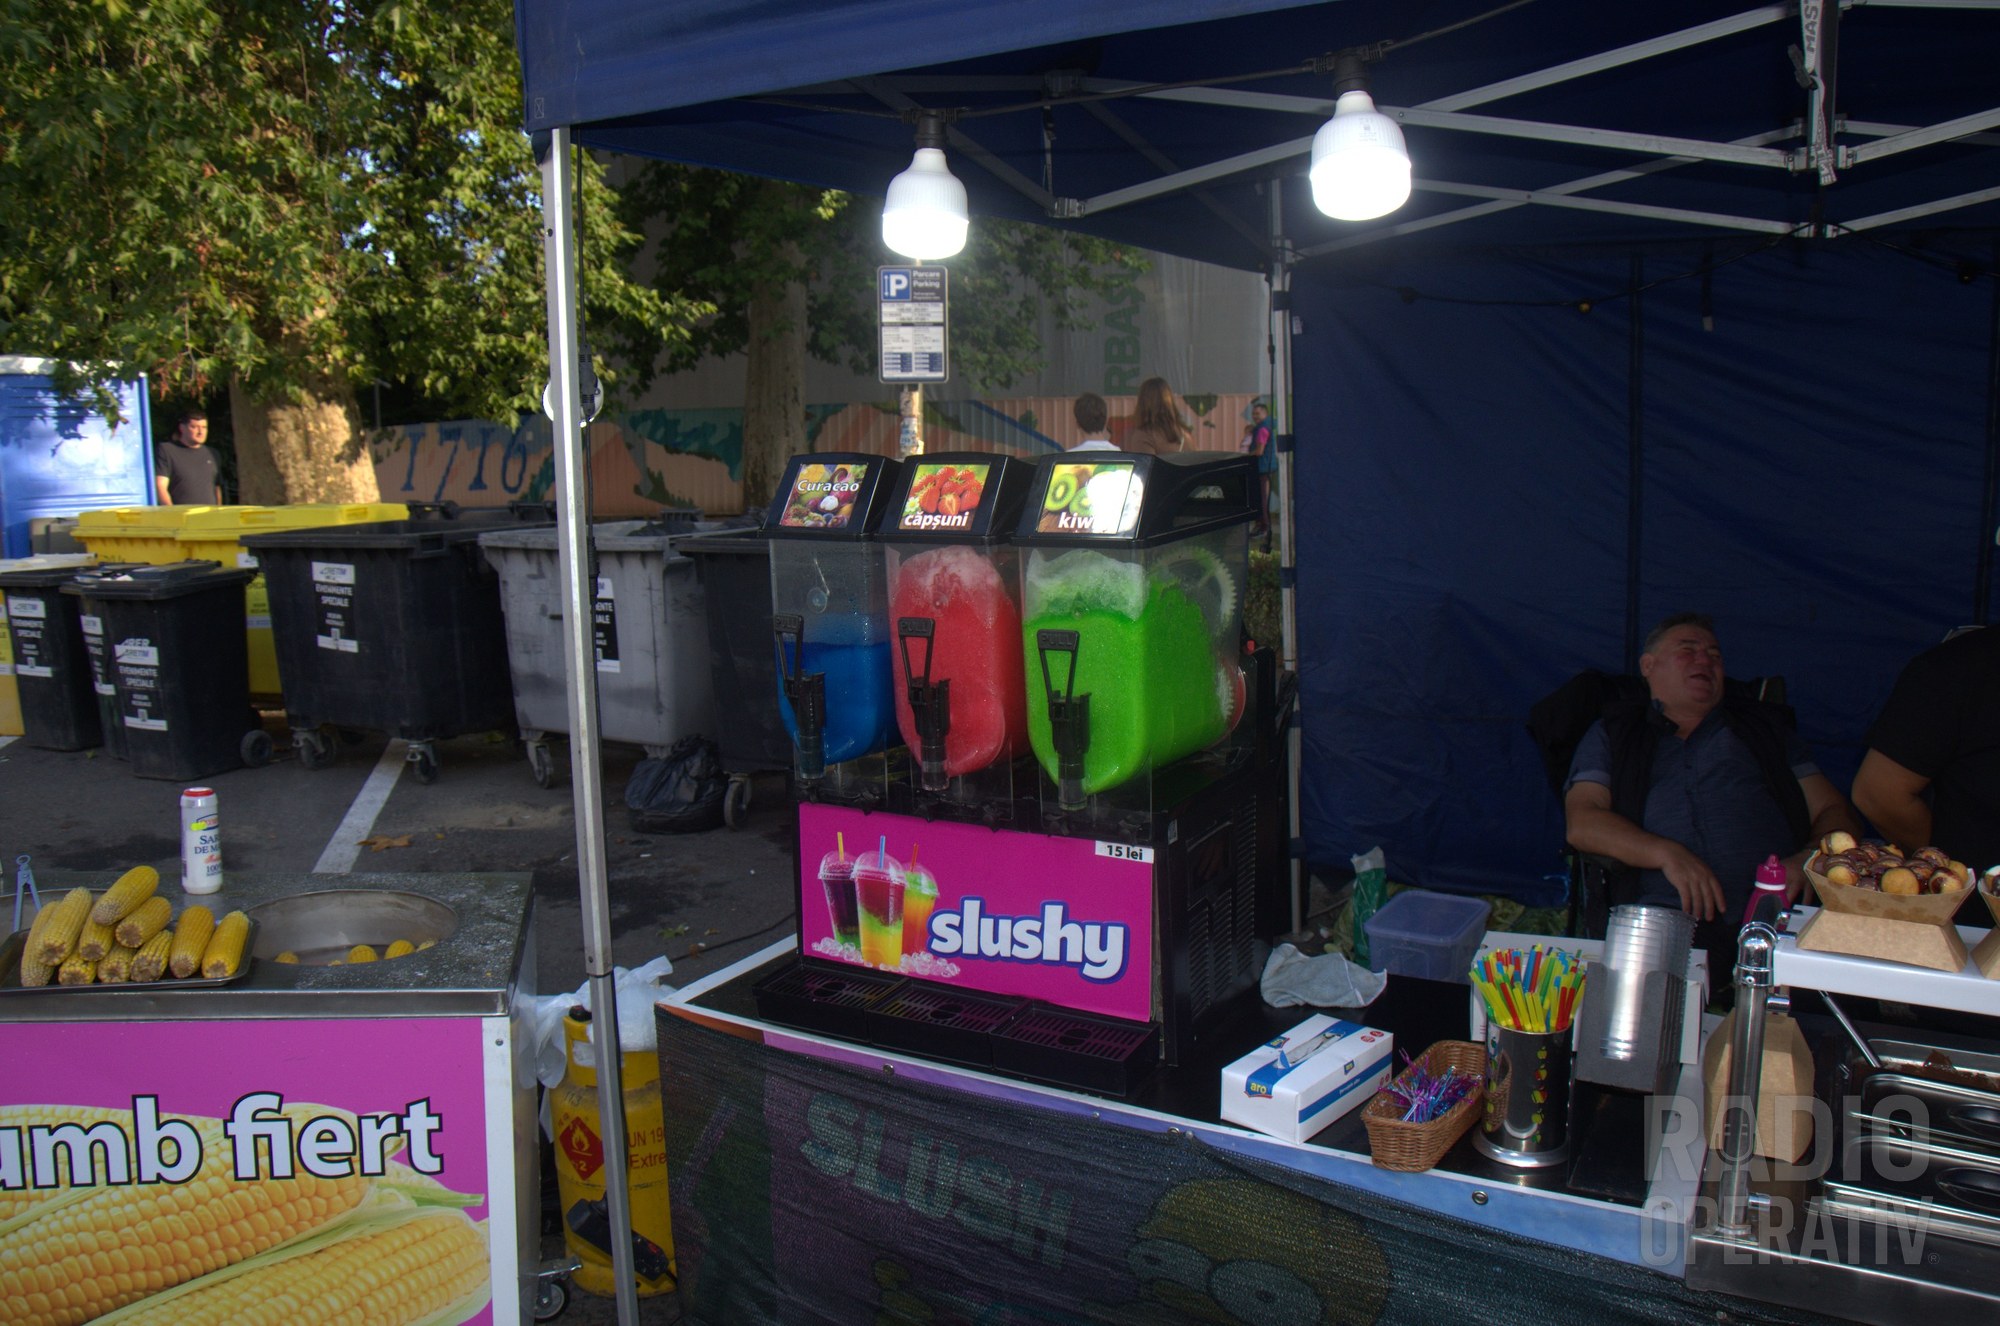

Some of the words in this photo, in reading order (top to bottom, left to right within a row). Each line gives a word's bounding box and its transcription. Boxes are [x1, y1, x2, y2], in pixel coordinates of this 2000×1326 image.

[1804, 0, 1818, 53] MAS
[912, 280, 940, 288] Parking
[1058, 511, 1095, 529] kiw
[900, 619, 930, 633] PULL
[1040, 633, 1073, 647] PULL
[1107, 844, 1123, 857] 15
[1126, 846, 1143, 860] lei
[929, 897, 1128, 983] slushy
[1250, 1082, 1267, 1094] aro
[223, 1091, 444, 1181] fiert
[800, 1092, 1074, 1270] SLUSH
